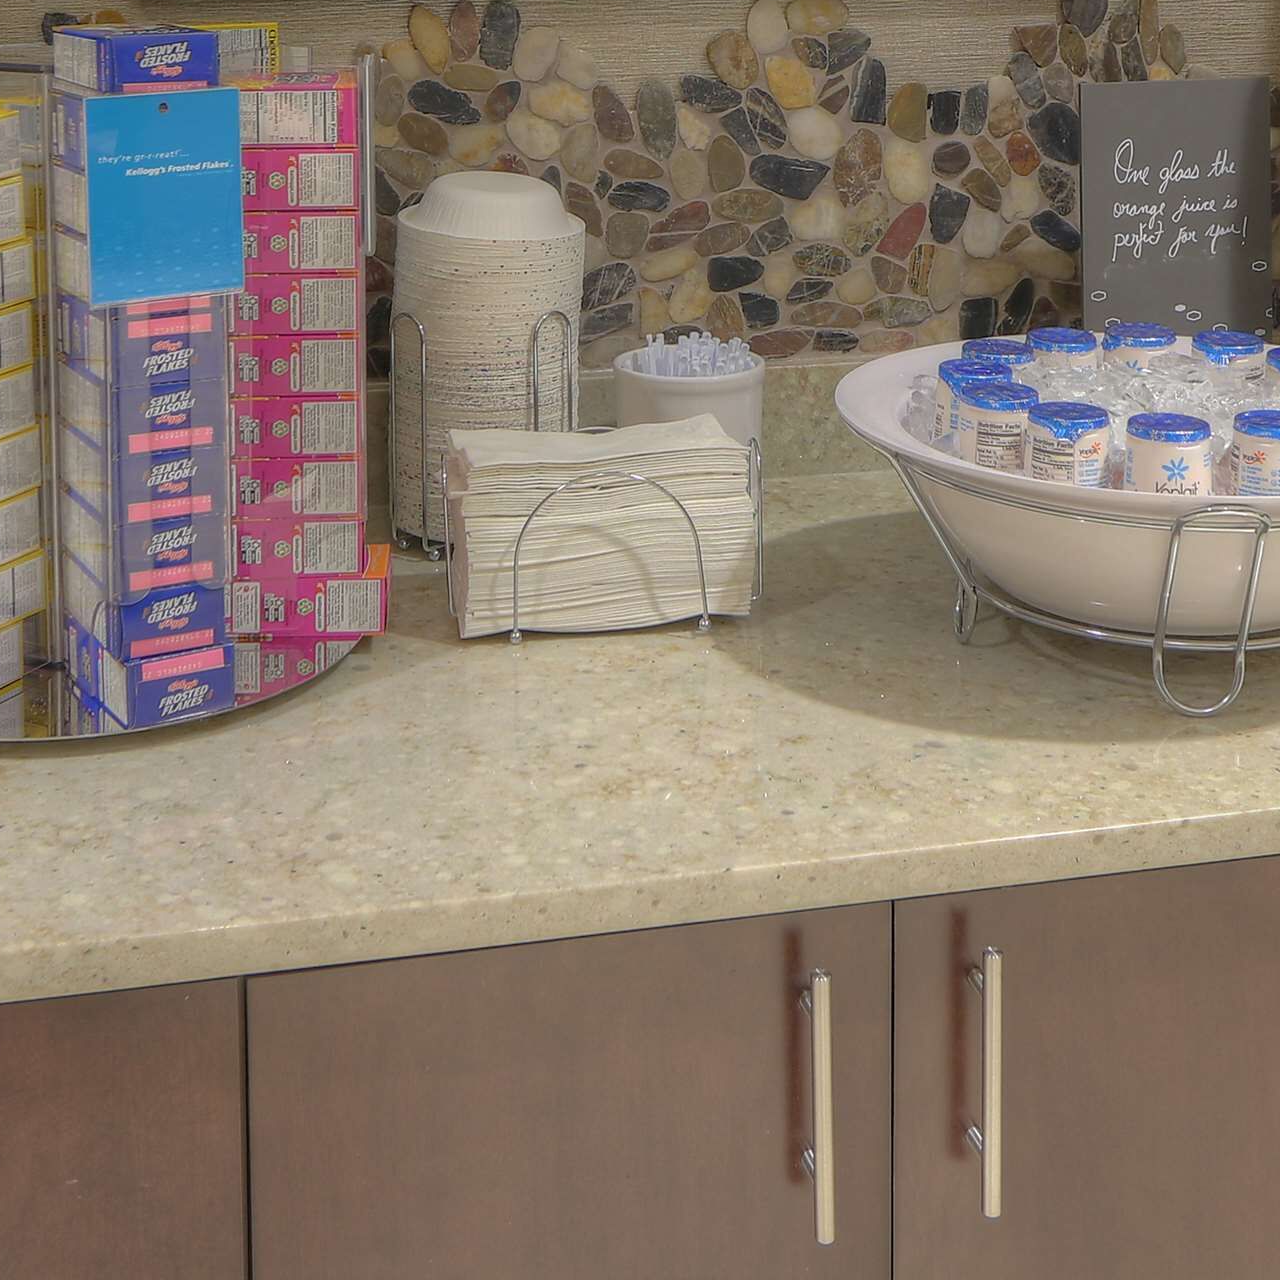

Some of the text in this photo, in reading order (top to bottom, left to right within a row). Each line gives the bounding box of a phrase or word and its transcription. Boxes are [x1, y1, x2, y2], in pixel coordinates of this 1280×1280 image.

[139, 51, 192, 69] FROSTED
[143, 40, 189, 59] FLAKES
[124, 166, 166, 177] Kellogg's
[167, 161, 202, 174] Frosted
[1114, 138, 1236, 194] One glass the
[1113, 194, 1238, 230] orange juice is
[1111, 215, 1248, 262] perfect for you!
[142, 348, 194, 369] FROSTED
[144, 358, 190, 377] FLAKES
[144, 397, 197, 419] FROSTED
[149, 389, 192, 408] FLAKES
[977, 422, 1003, 430] Nutrition
[146, 466, 198, 488] FROSTED
[151, 457, 195, 477] FLAKES
[146, 534, 198, 556] FROSTED
[151, 524, 194, 545] FLAKES
[146, 600, 199, 625] FROSTED
[151, 591, 195, 614] FLAKES
[158, 683, 210, 709] FROSTED
[160, 696, 204, 718] FLAKES
